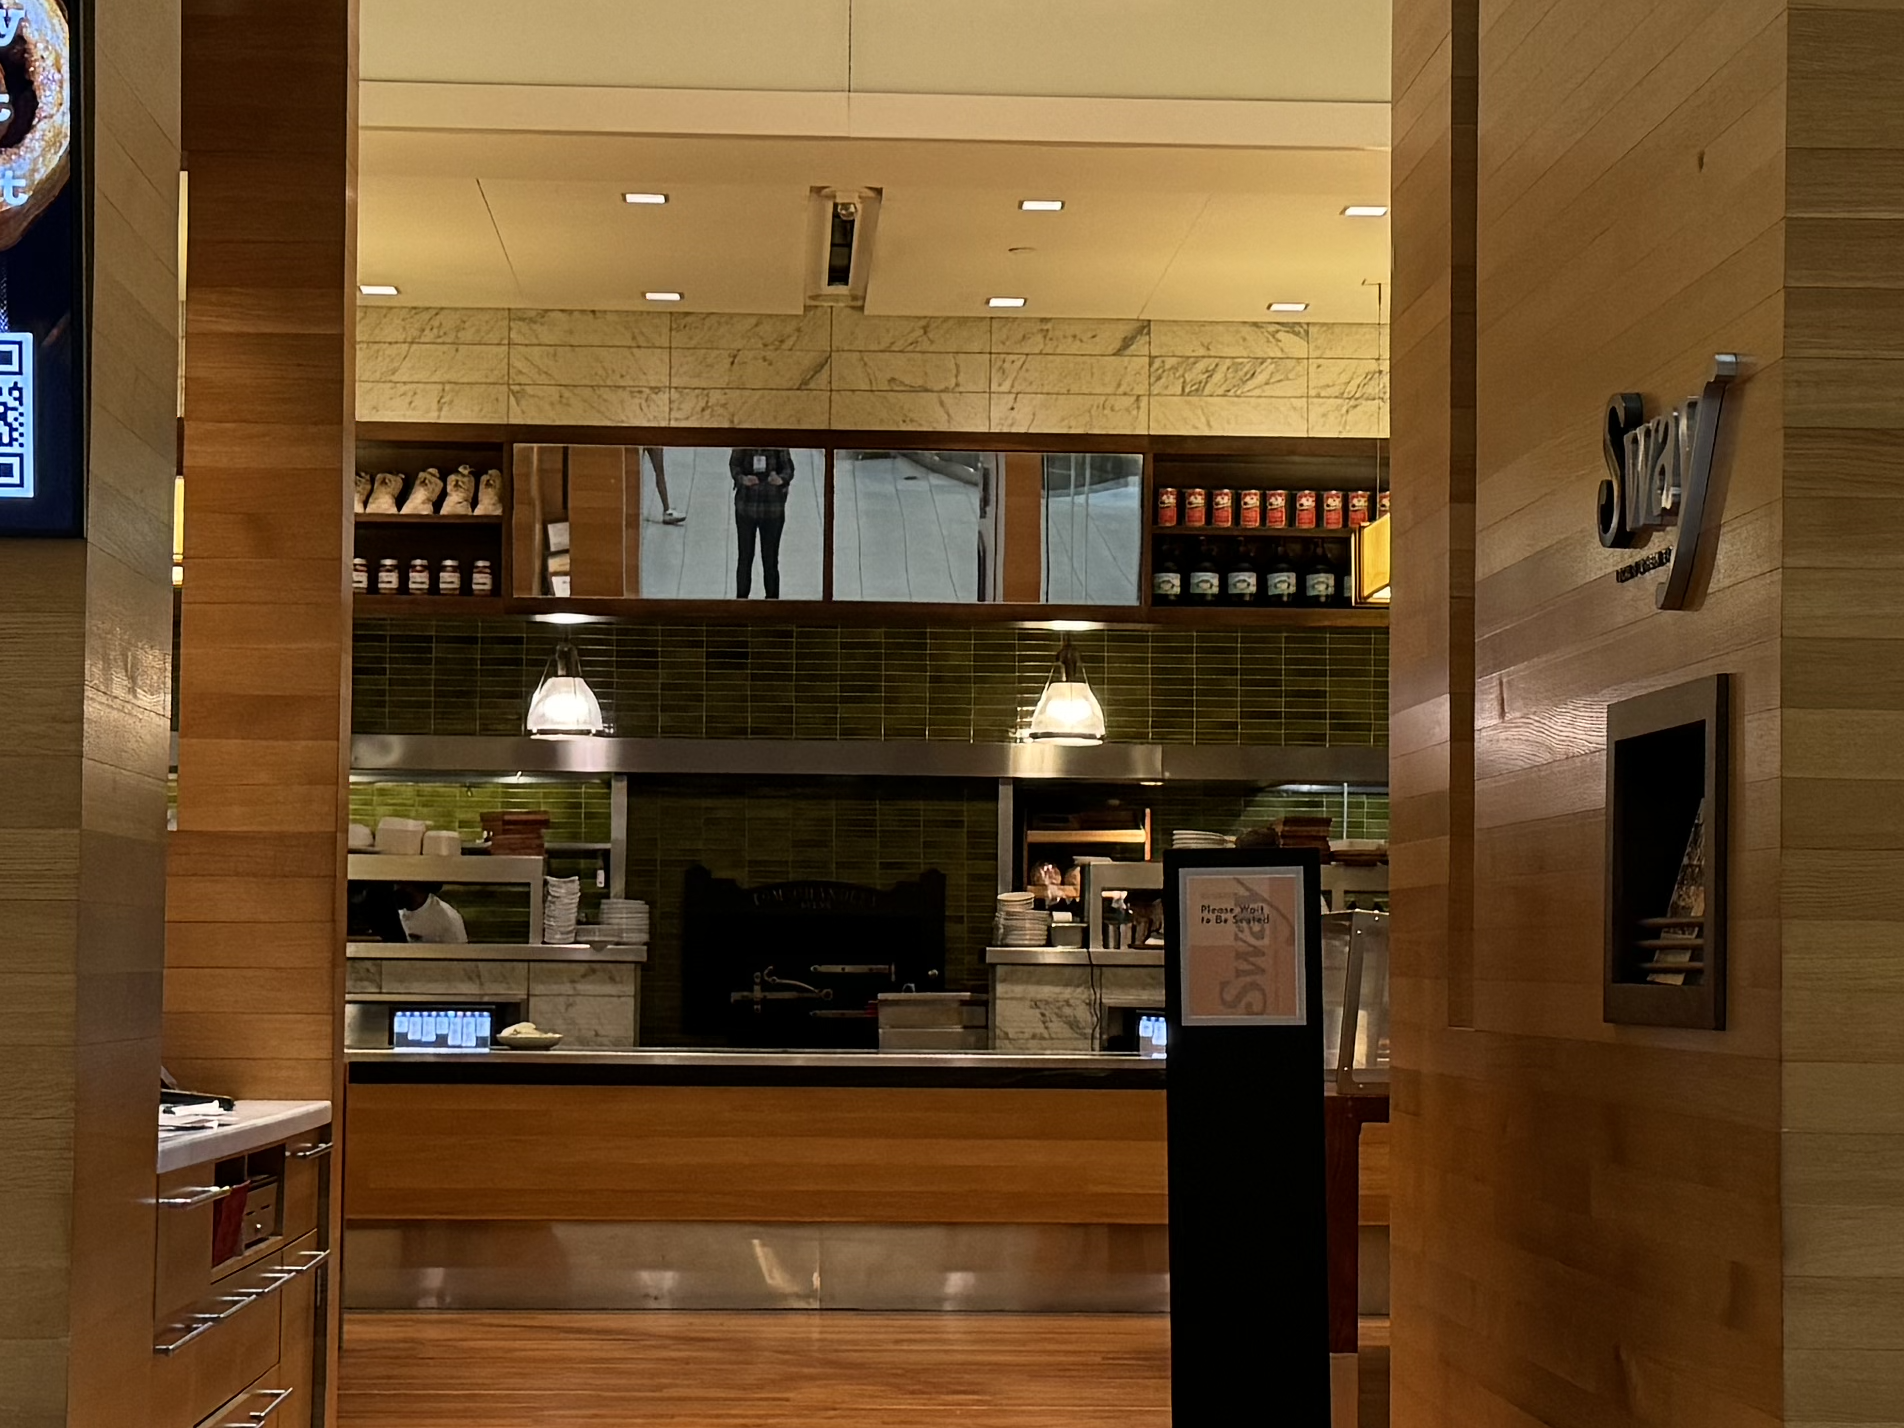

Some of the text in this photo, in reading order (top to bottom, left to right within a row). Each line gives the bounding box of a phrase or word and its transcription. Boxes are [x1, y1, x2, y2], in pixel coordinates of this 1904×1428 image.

[1201, 904, 1264, 915] Please Wait
[1201, 914, 1270, 925] to Be Seated
